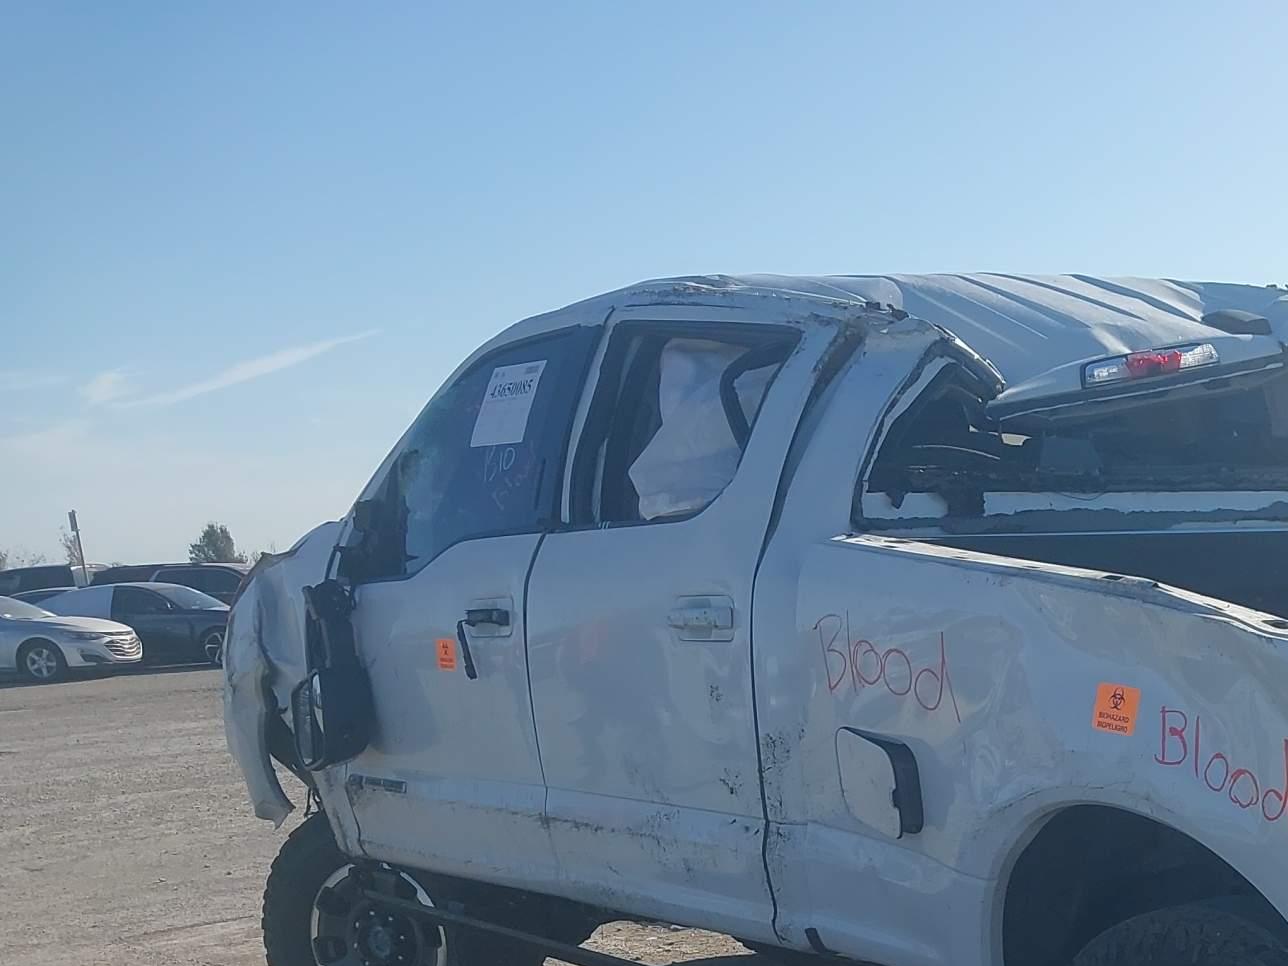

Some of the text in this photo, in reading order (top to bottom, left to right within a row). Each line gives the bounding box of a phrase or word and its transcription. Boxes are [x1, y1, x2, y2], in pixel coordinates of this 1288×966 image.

[813, 609, 960, 723] Blood
[1098, 711, 1130, 723] BIOHAZARD
[1096, 720, 1128, 733] BIOPELIGRO
